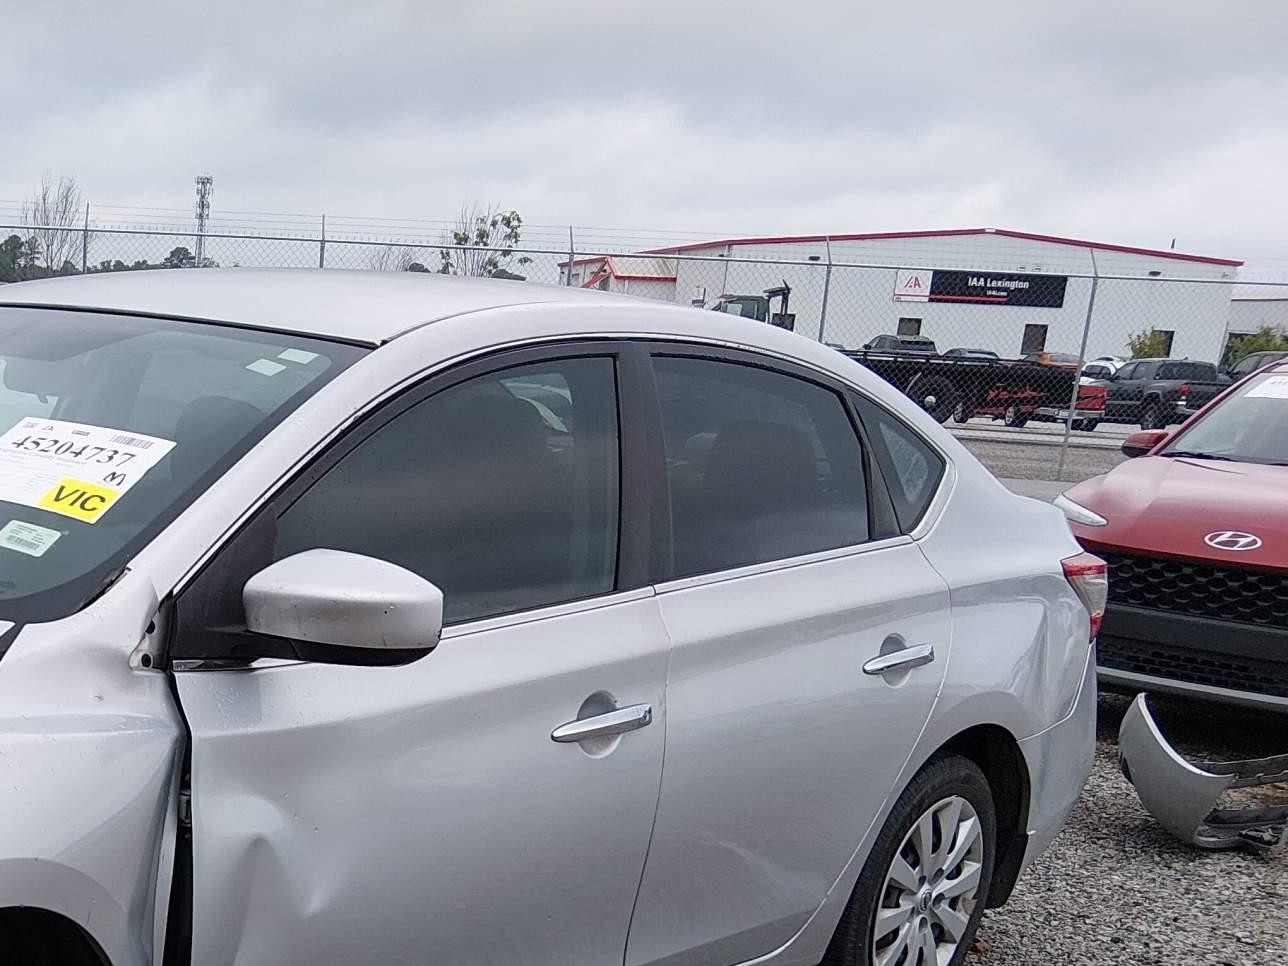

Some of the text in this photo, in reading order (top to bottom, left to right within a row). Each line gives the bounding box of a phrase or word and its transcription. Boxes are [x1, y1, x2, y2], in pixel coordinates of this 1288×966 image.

[968, 277, 1030, 290] IAA Lexington
[11, 435, 136, 467] 45204737
[53, 485, 106, 512] VIC
